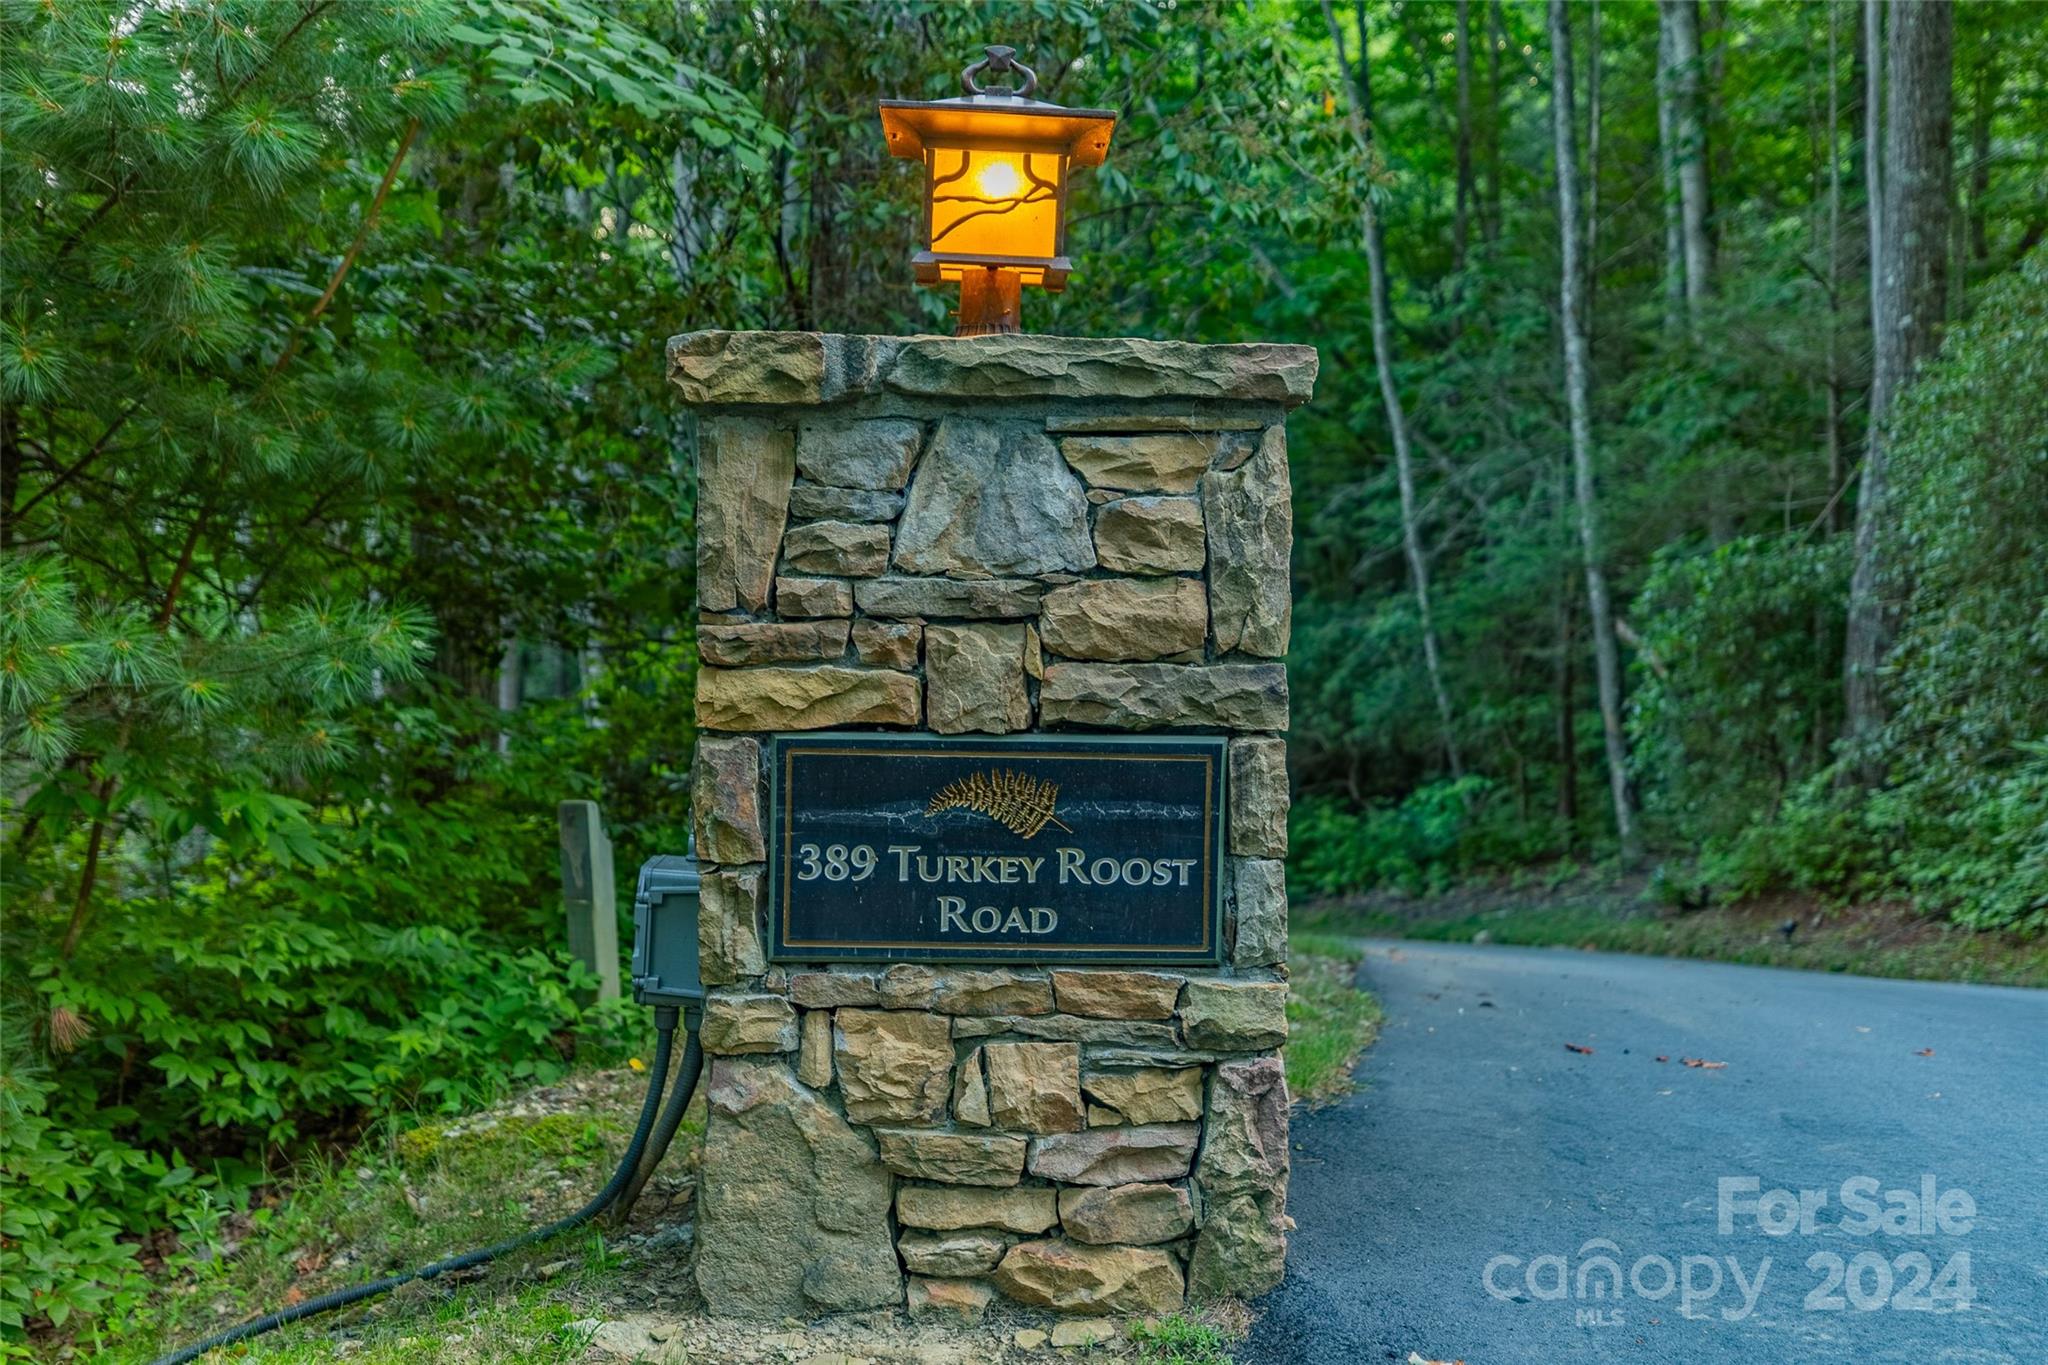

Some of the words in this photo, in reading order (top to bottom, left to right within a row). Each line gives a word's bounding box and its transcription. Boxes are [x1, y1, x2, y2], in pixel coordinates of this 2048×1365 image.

[798, 843, 878, 882] 389
[887, 845, 1045, 884] TURKEY
[1056, 847, 1198, 886] ROOST
[936, 895, 1059, 935] ROAD
